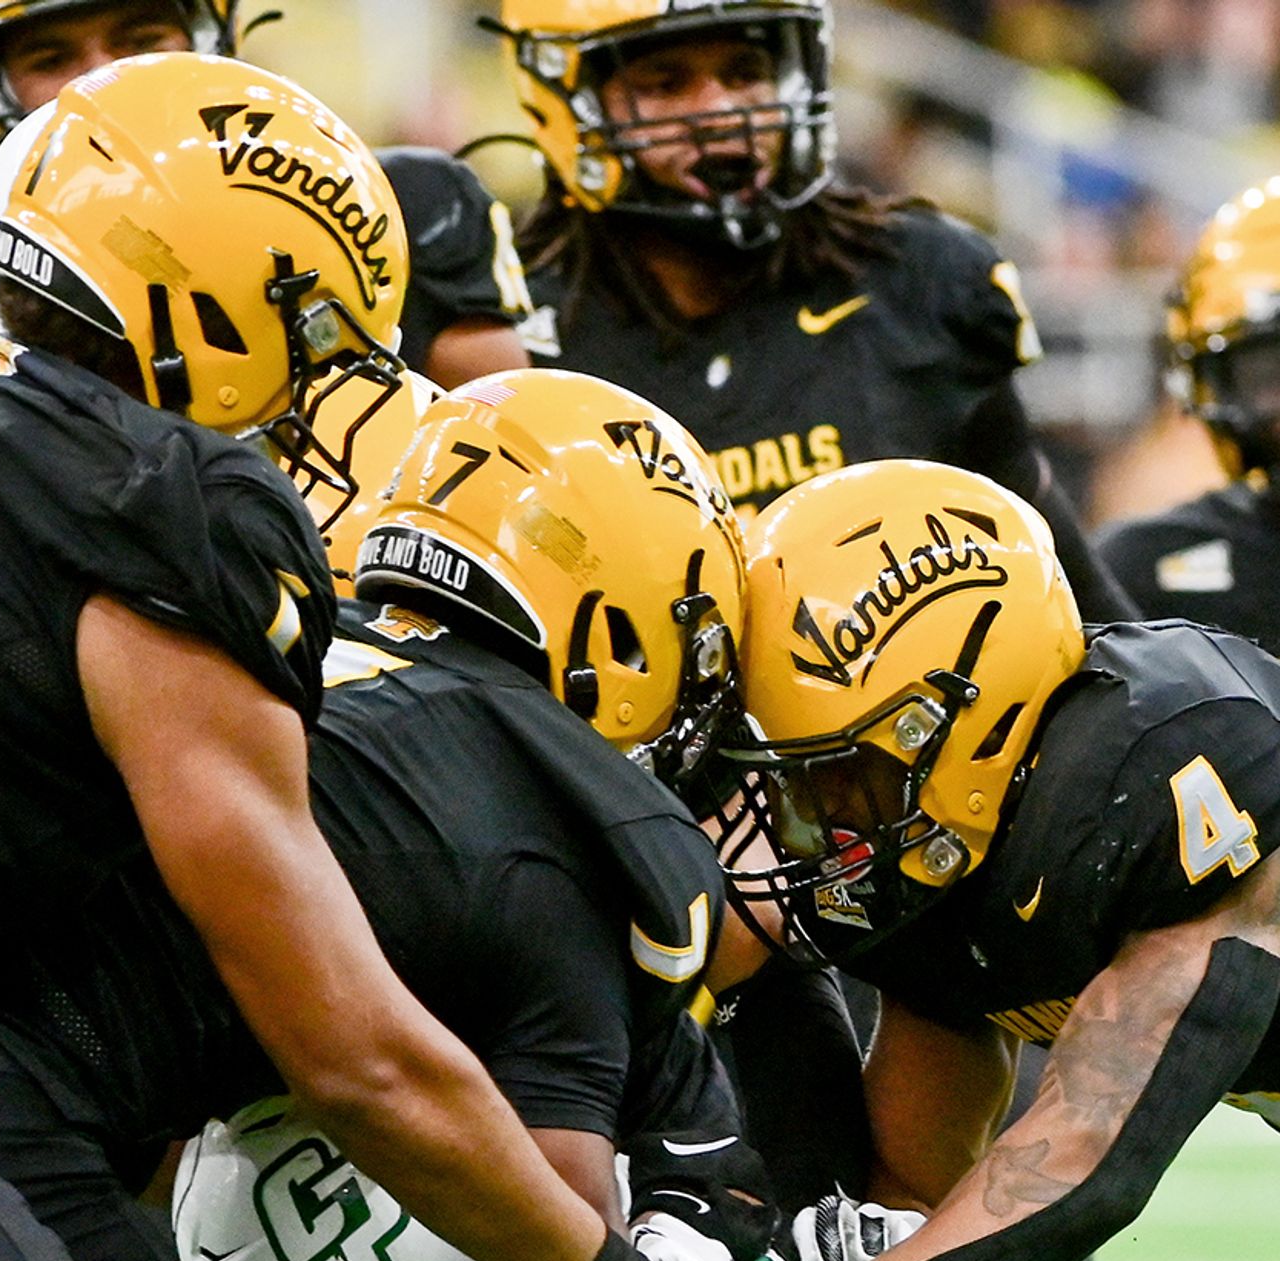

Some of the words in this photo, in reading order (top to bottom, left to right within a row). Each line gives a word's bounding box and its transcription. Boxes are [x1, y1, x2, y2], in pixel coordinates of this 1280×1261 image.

[199, 104, 391, 288] Vandals
[12, 238, 54, 287] BOLD
[424, 441, 491, 506] 7
[709, 424, 844, 500] DALS
[382, 535, 419, 569] AND
[418, 544, 471, 592] BOLD
[790, 513, 988, 687] Vandals
[1169, 754, 1261, 885] 4
